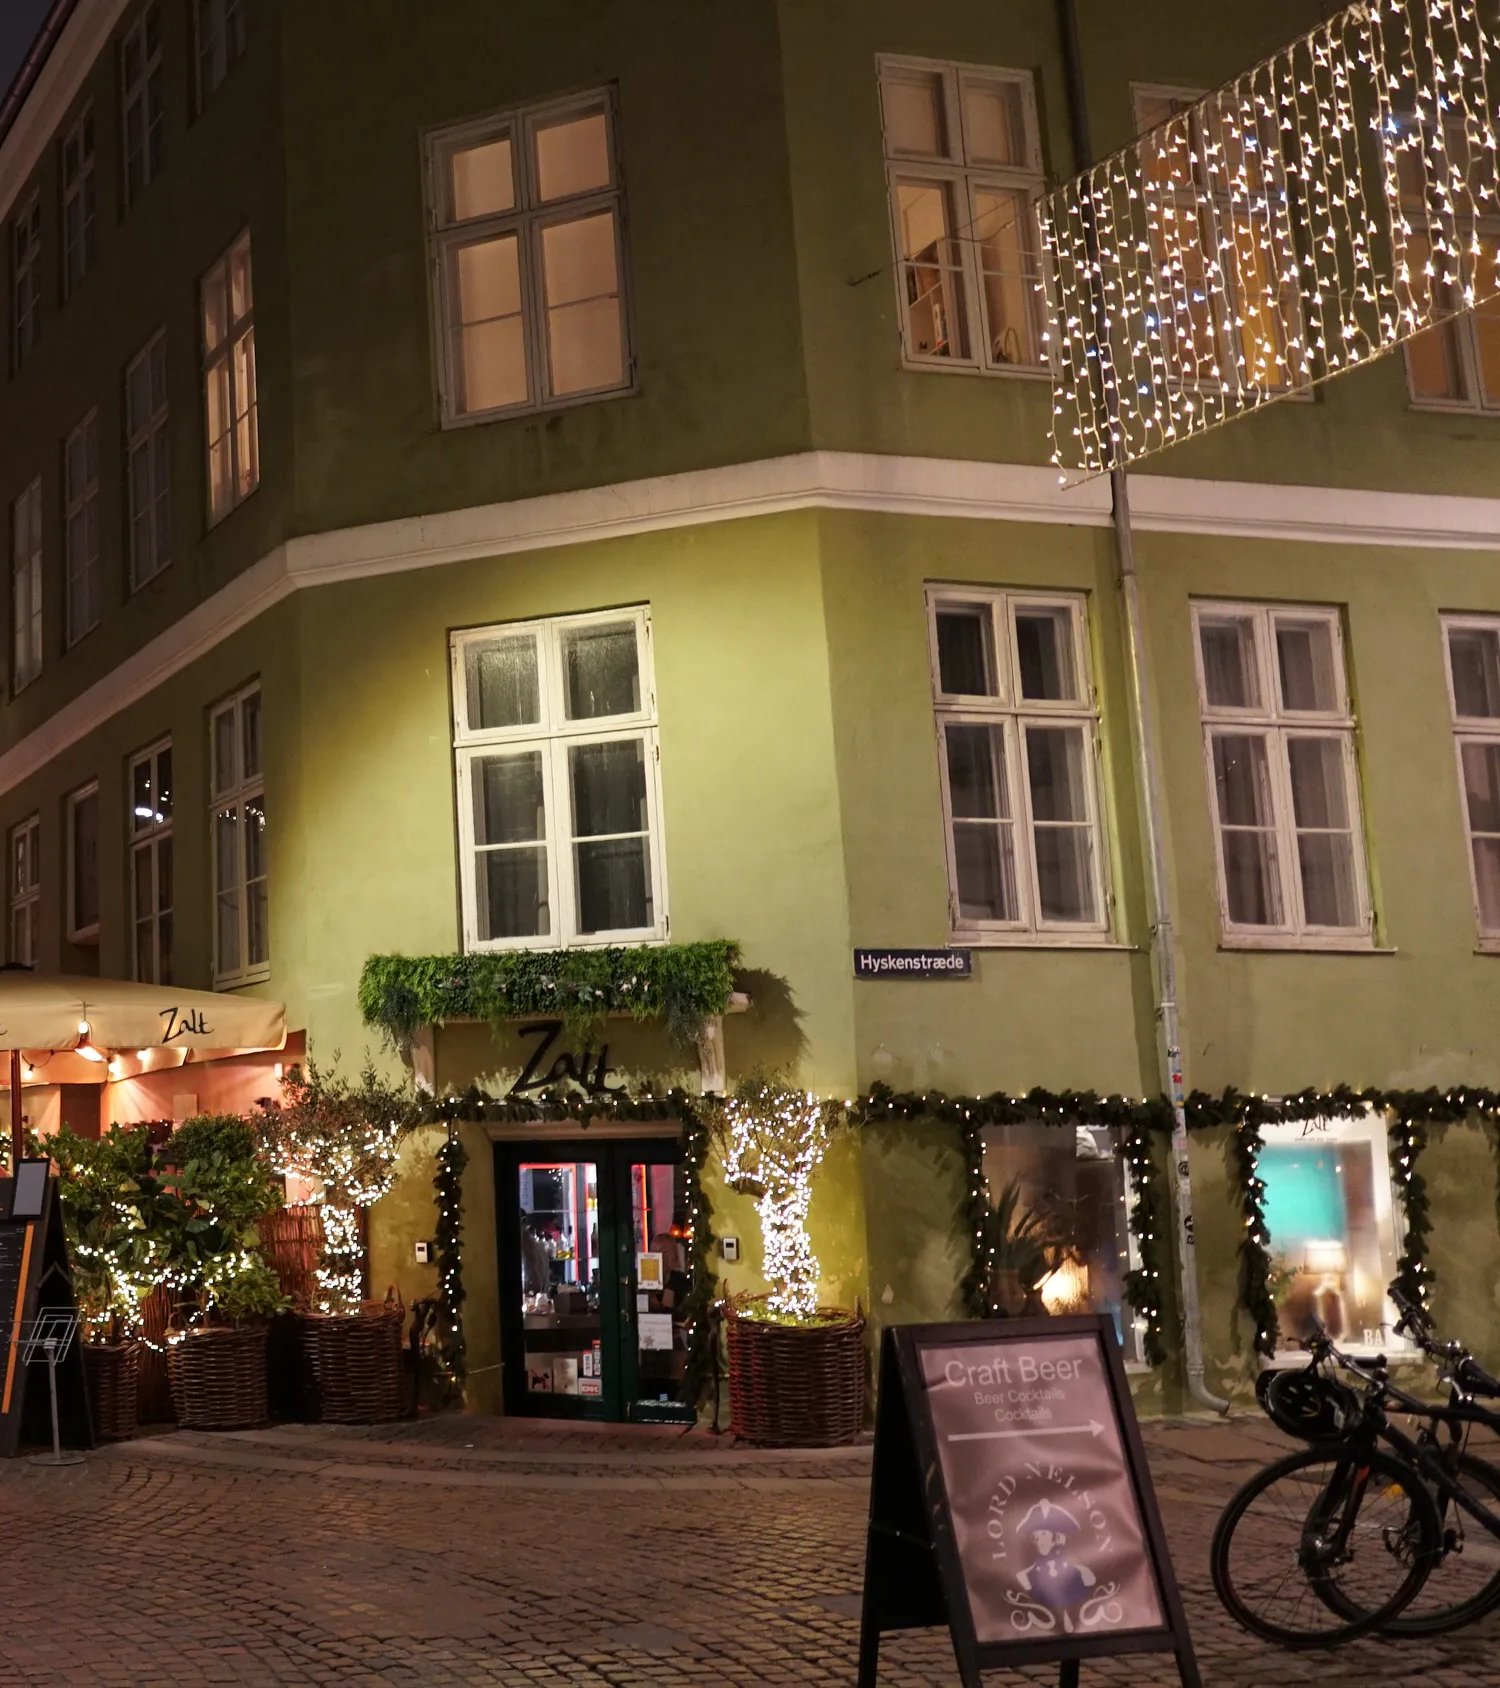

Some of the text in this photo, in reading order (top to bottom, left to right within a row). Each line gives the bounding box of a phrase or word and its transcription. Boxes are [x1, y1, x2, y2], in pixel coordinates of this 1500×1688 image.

[860, 954, 964, 973] Hyskenstræde
[159, 1007, 215, 1044] Zalt
[504, 1021, 627, 1099] Zalt
[944, 1355, 1083, 1387] Craft Beer
[974, 1387, 1066, 1405] Beer Cocktails
[995, 1405, 1053, 1422] Cocktails
[987, 1460, 1114, 1561] LORD NELSON
